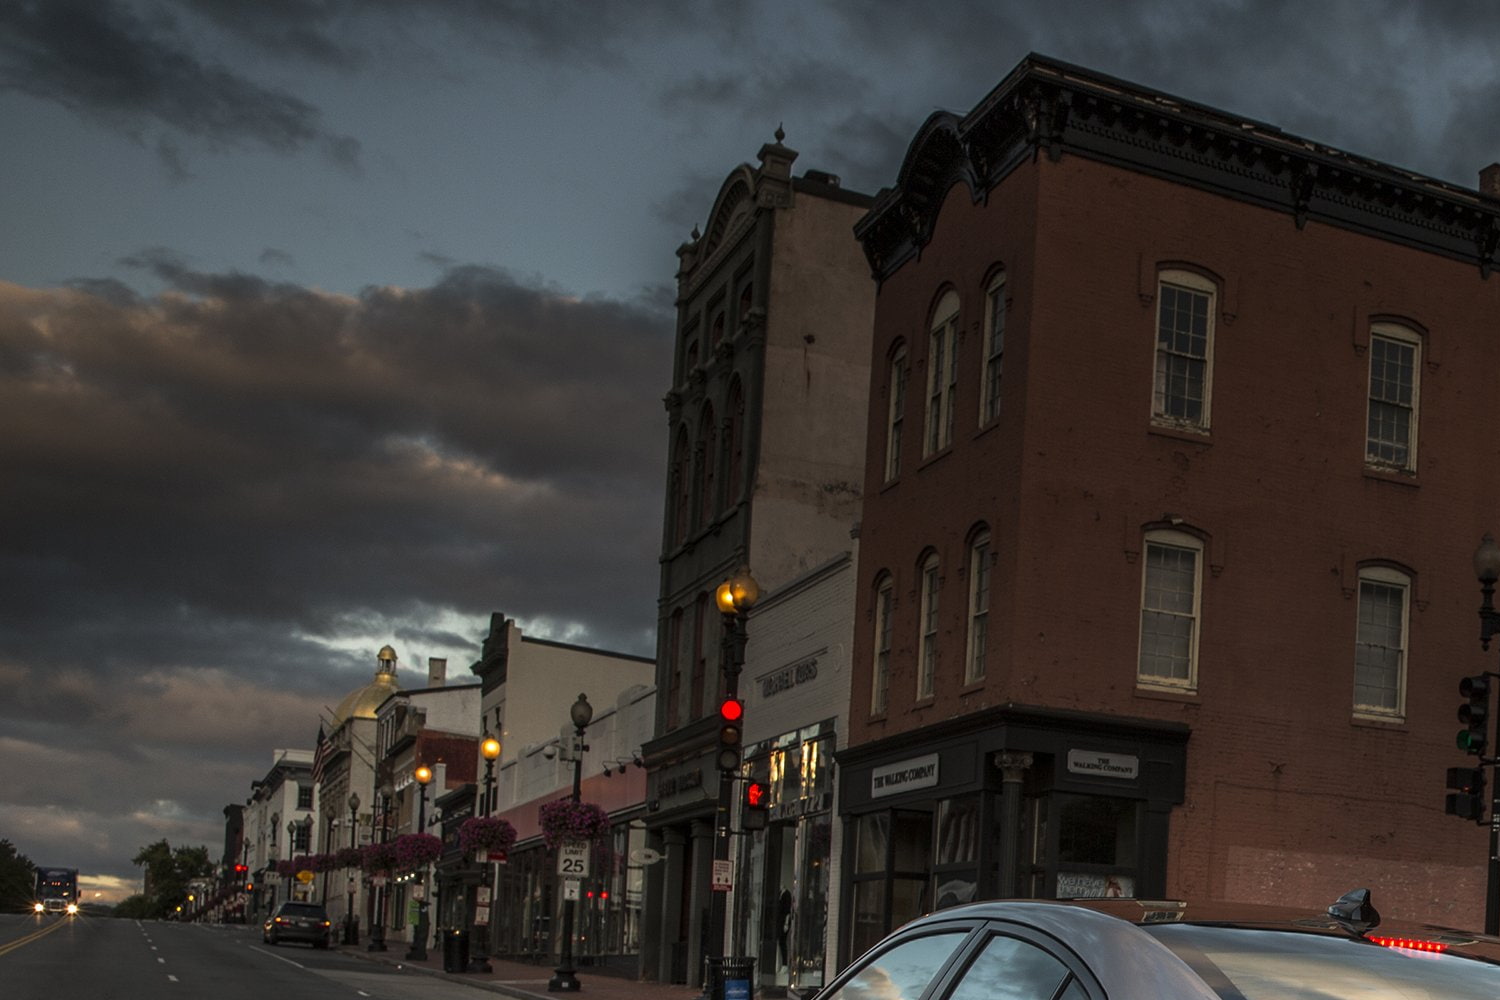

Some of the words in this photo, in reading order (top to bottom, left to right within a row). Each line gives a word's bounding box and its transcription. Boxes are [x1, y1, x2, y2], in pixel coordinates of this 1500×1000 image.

[885, 768, 908, 786] WALKING
[908, 763, 936, 781] COMPANY
[1073, 761, 1102, 770] WALKING
[1103, 764, 1133, 774] COMPANY
[562, 858, 584, 873] 25
